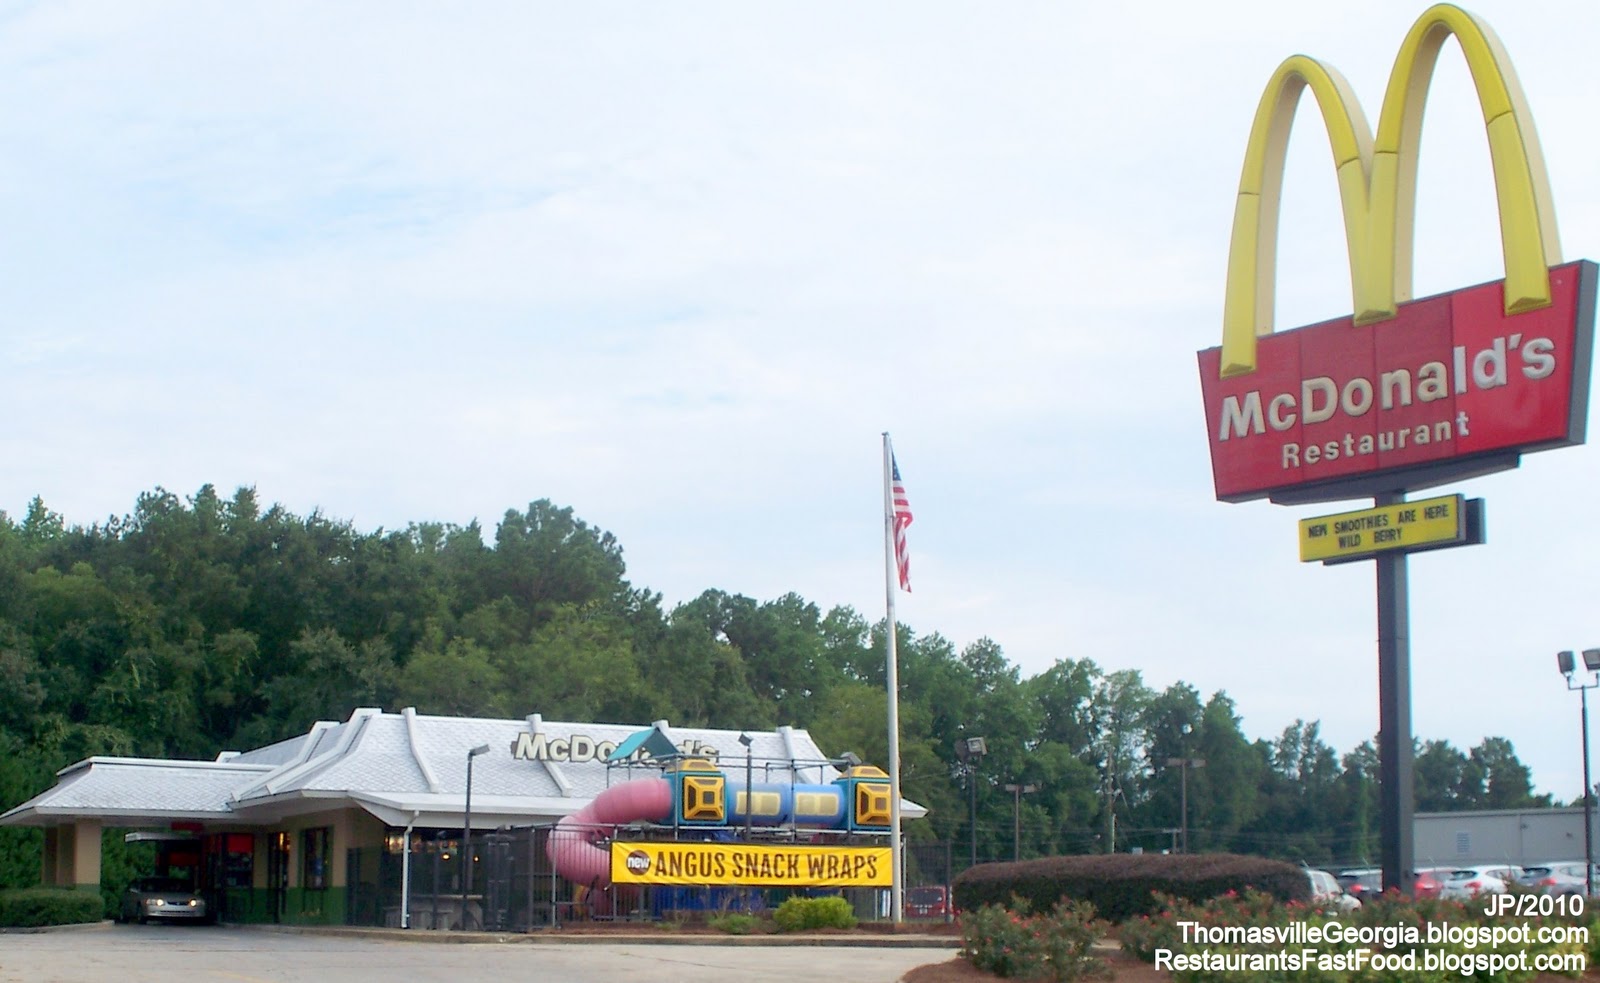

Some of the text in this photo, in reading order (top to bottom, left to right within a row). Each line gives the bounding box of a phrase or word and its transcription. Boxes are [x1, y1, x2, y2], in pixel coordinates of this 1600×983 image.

[1219, 333, 1556, 441] McDonald's
[1281, 411, 1470, 469] Restaurant
[1308, 505, 1448, 538] NEW SMOOTHIES ARE HERE
[1338, 528, 1402, 549] WILD BERRY
[627, 851, 878, 880] new ANGUS SNACK WRAPS
